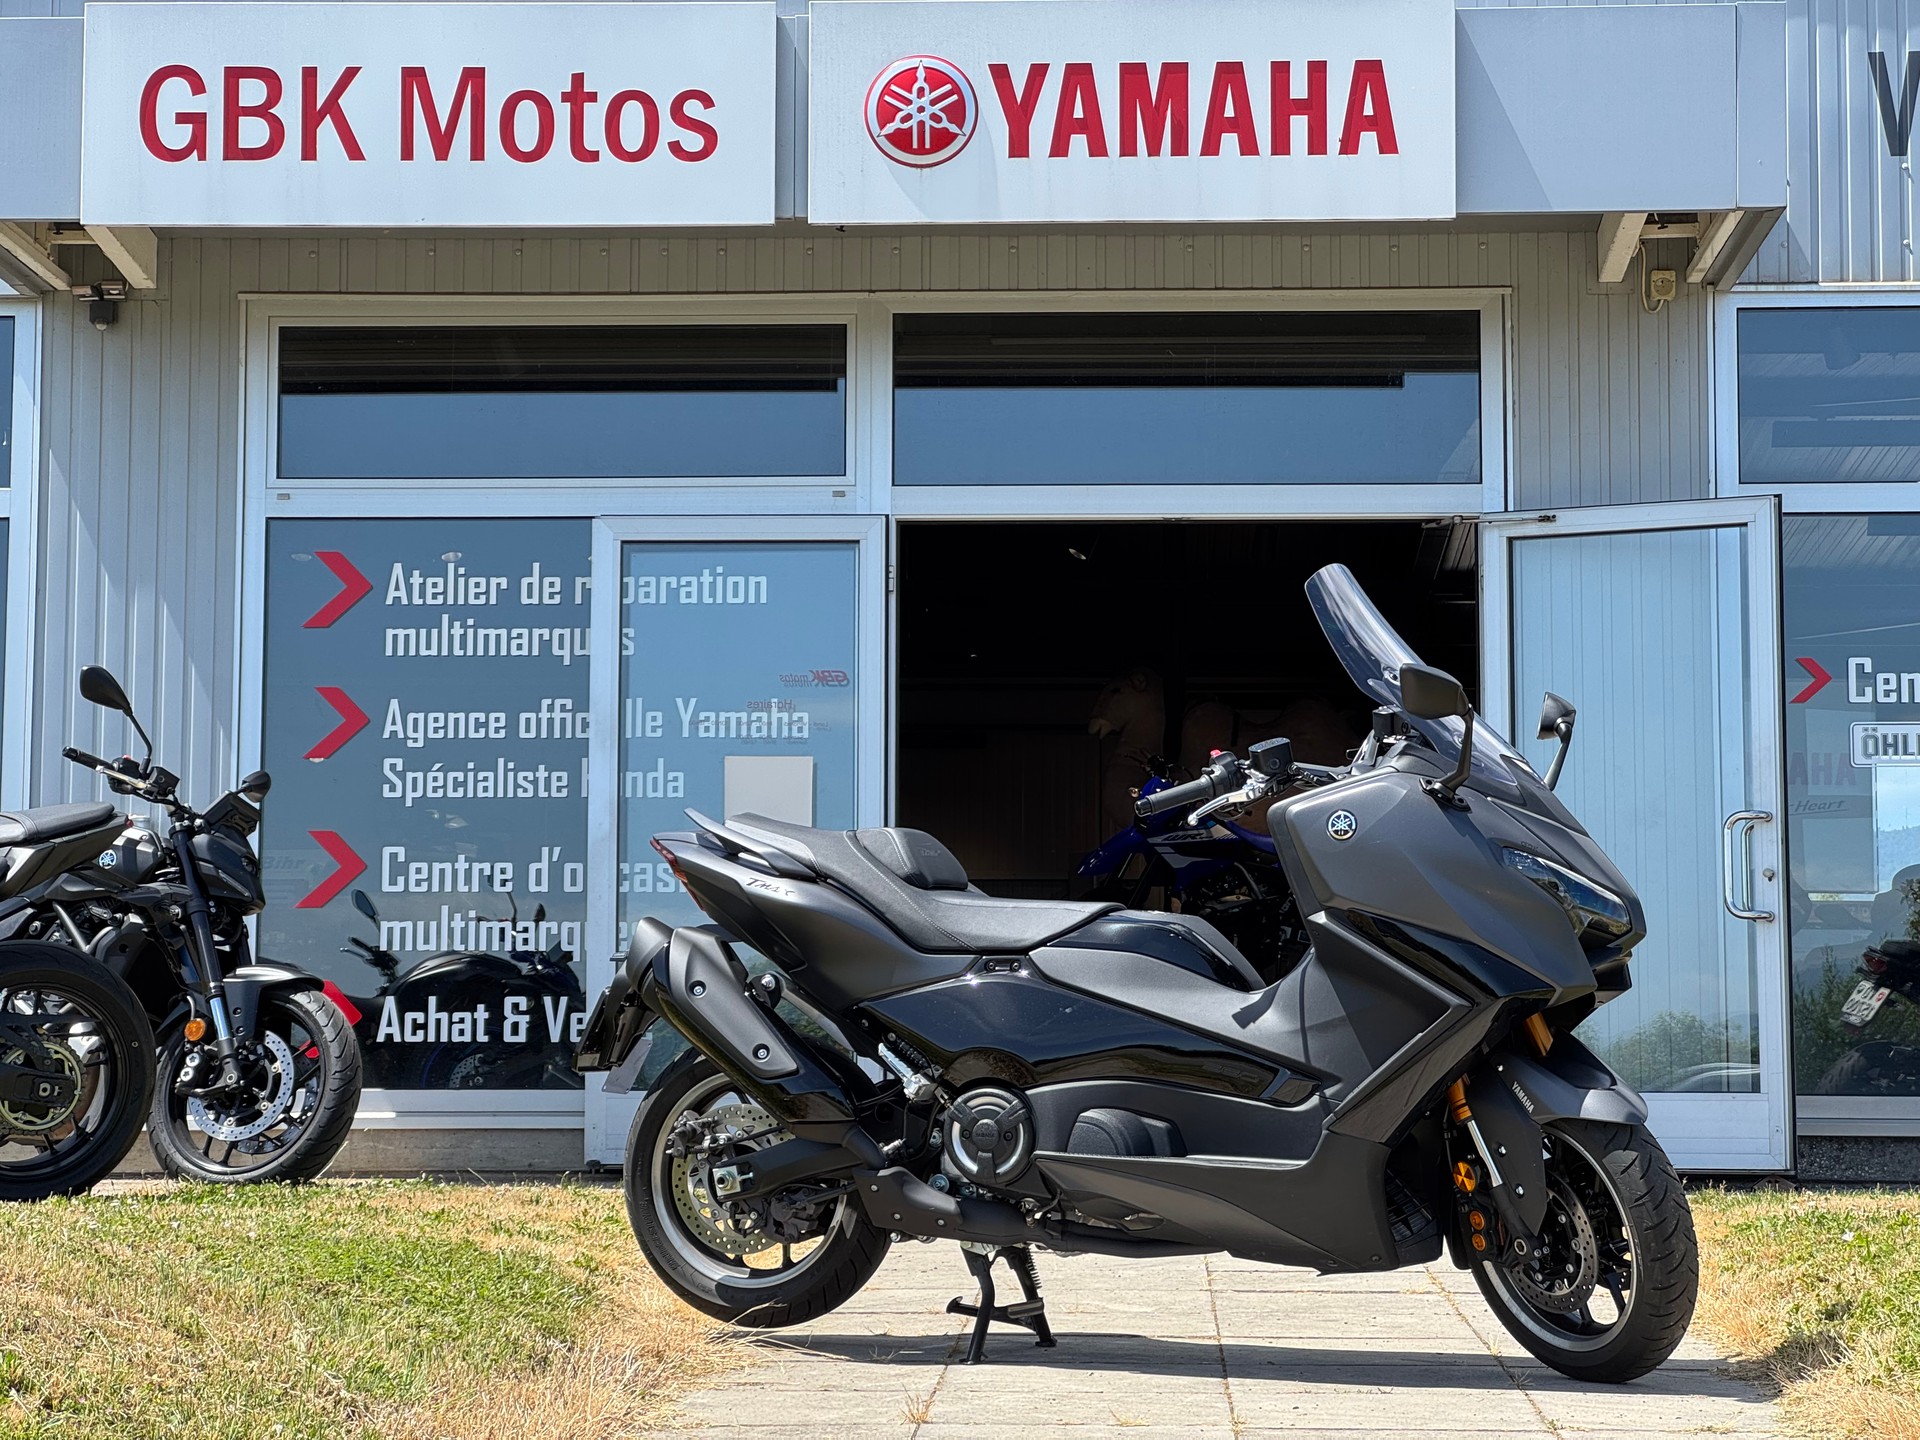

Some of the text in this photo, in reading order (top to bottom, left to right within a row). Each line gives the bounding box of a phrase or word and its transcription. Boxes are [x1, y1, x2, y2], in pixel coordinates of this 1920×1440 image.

[139, 64, 720, 164] GBK Motos
[988, 60, 1399, 158] YAMAHA
[1867, 51, 1920, 156] V
[385, 562, 768, 605] Atelier de rparation
[385, 614, 635, 666] multimarqus
[382, 697, 809, 748] Agence officlle Yamaha
[382, 757, 569, 808] Spécialiste
[381, 846, 513, 893] Centre
[376, 996, 490, 1043] Achat
[503, 996, 530, 1043] &
[1512, 1081, 1535, 1114] YAMAHA
